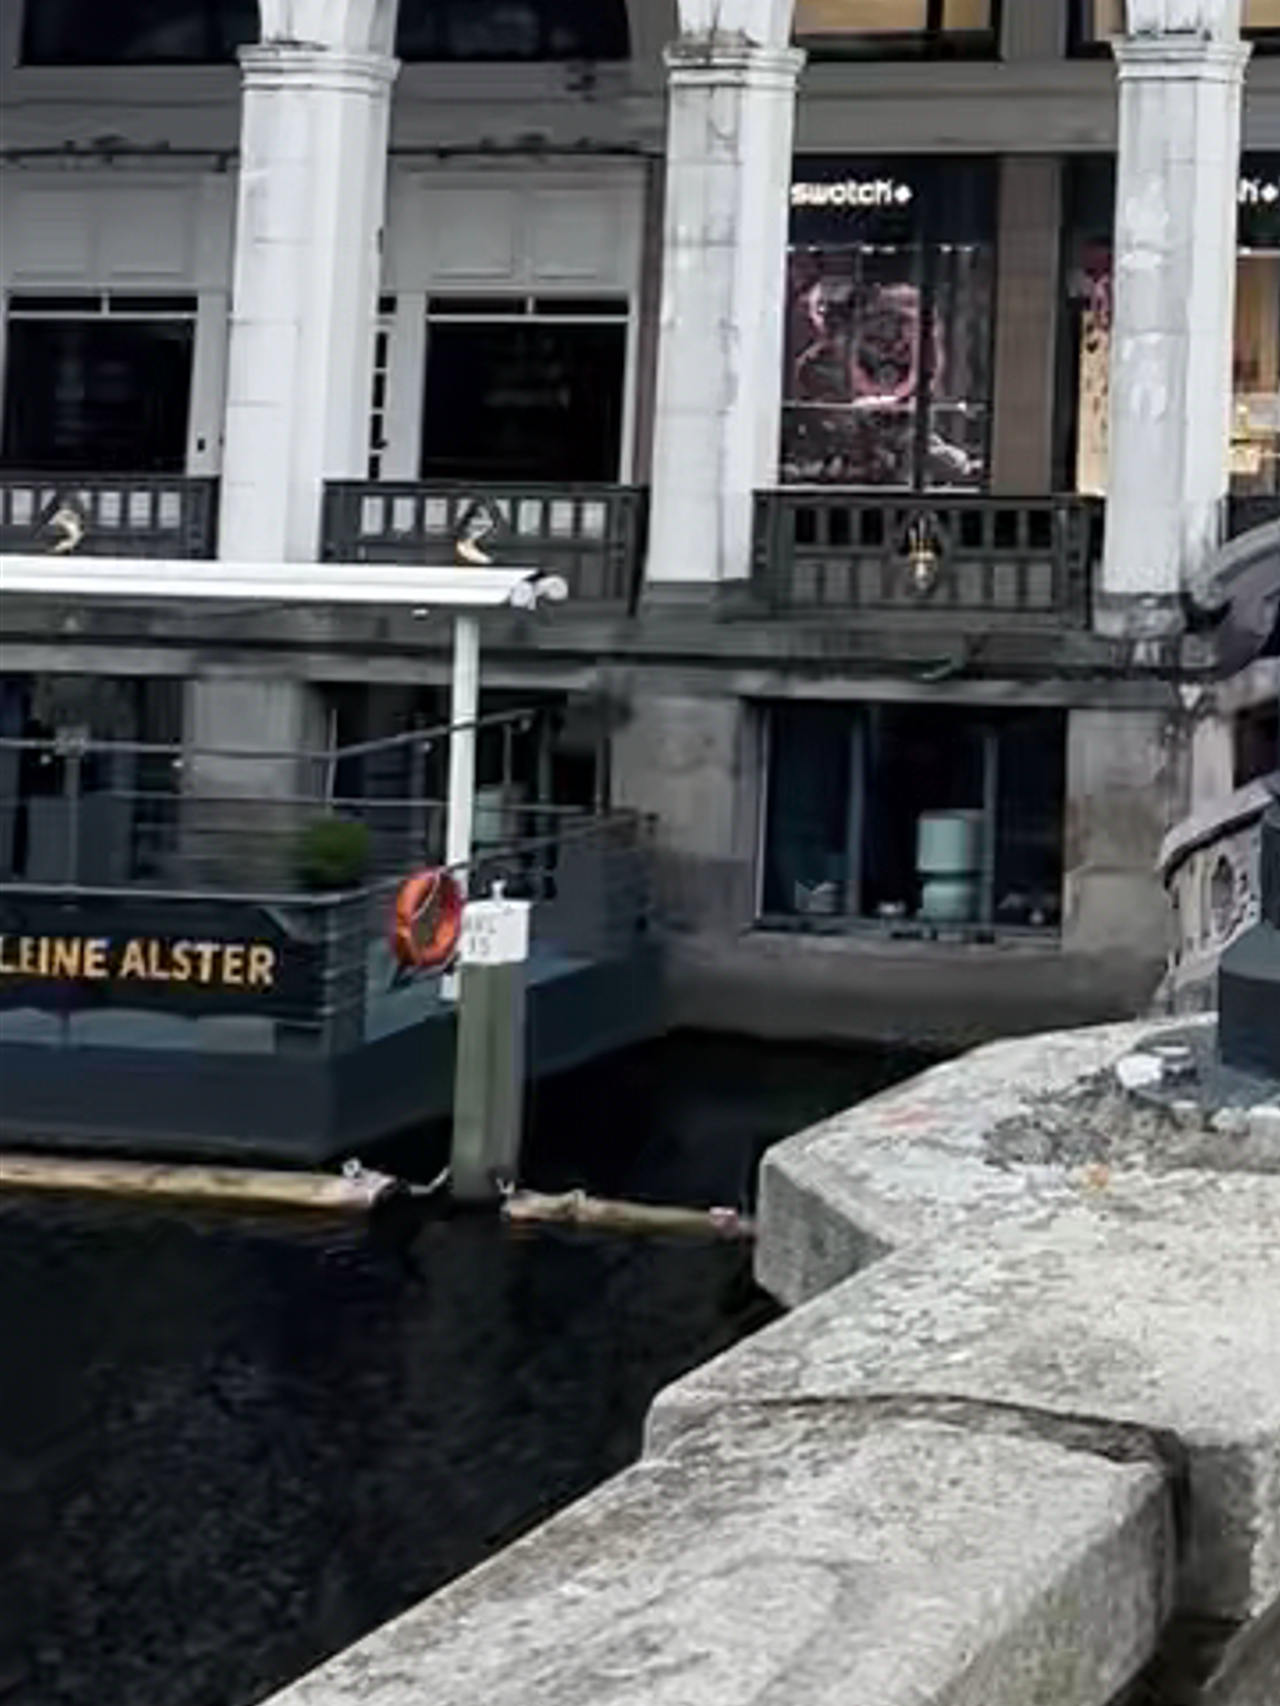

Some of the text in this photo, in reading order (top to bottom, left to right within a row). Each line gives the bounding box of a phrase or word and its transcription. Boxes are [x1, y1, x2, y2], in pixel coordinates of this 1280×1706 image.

[790, 179, 895, 206] swatch
[0, 936, 276, 985] LEINE ALSTER
